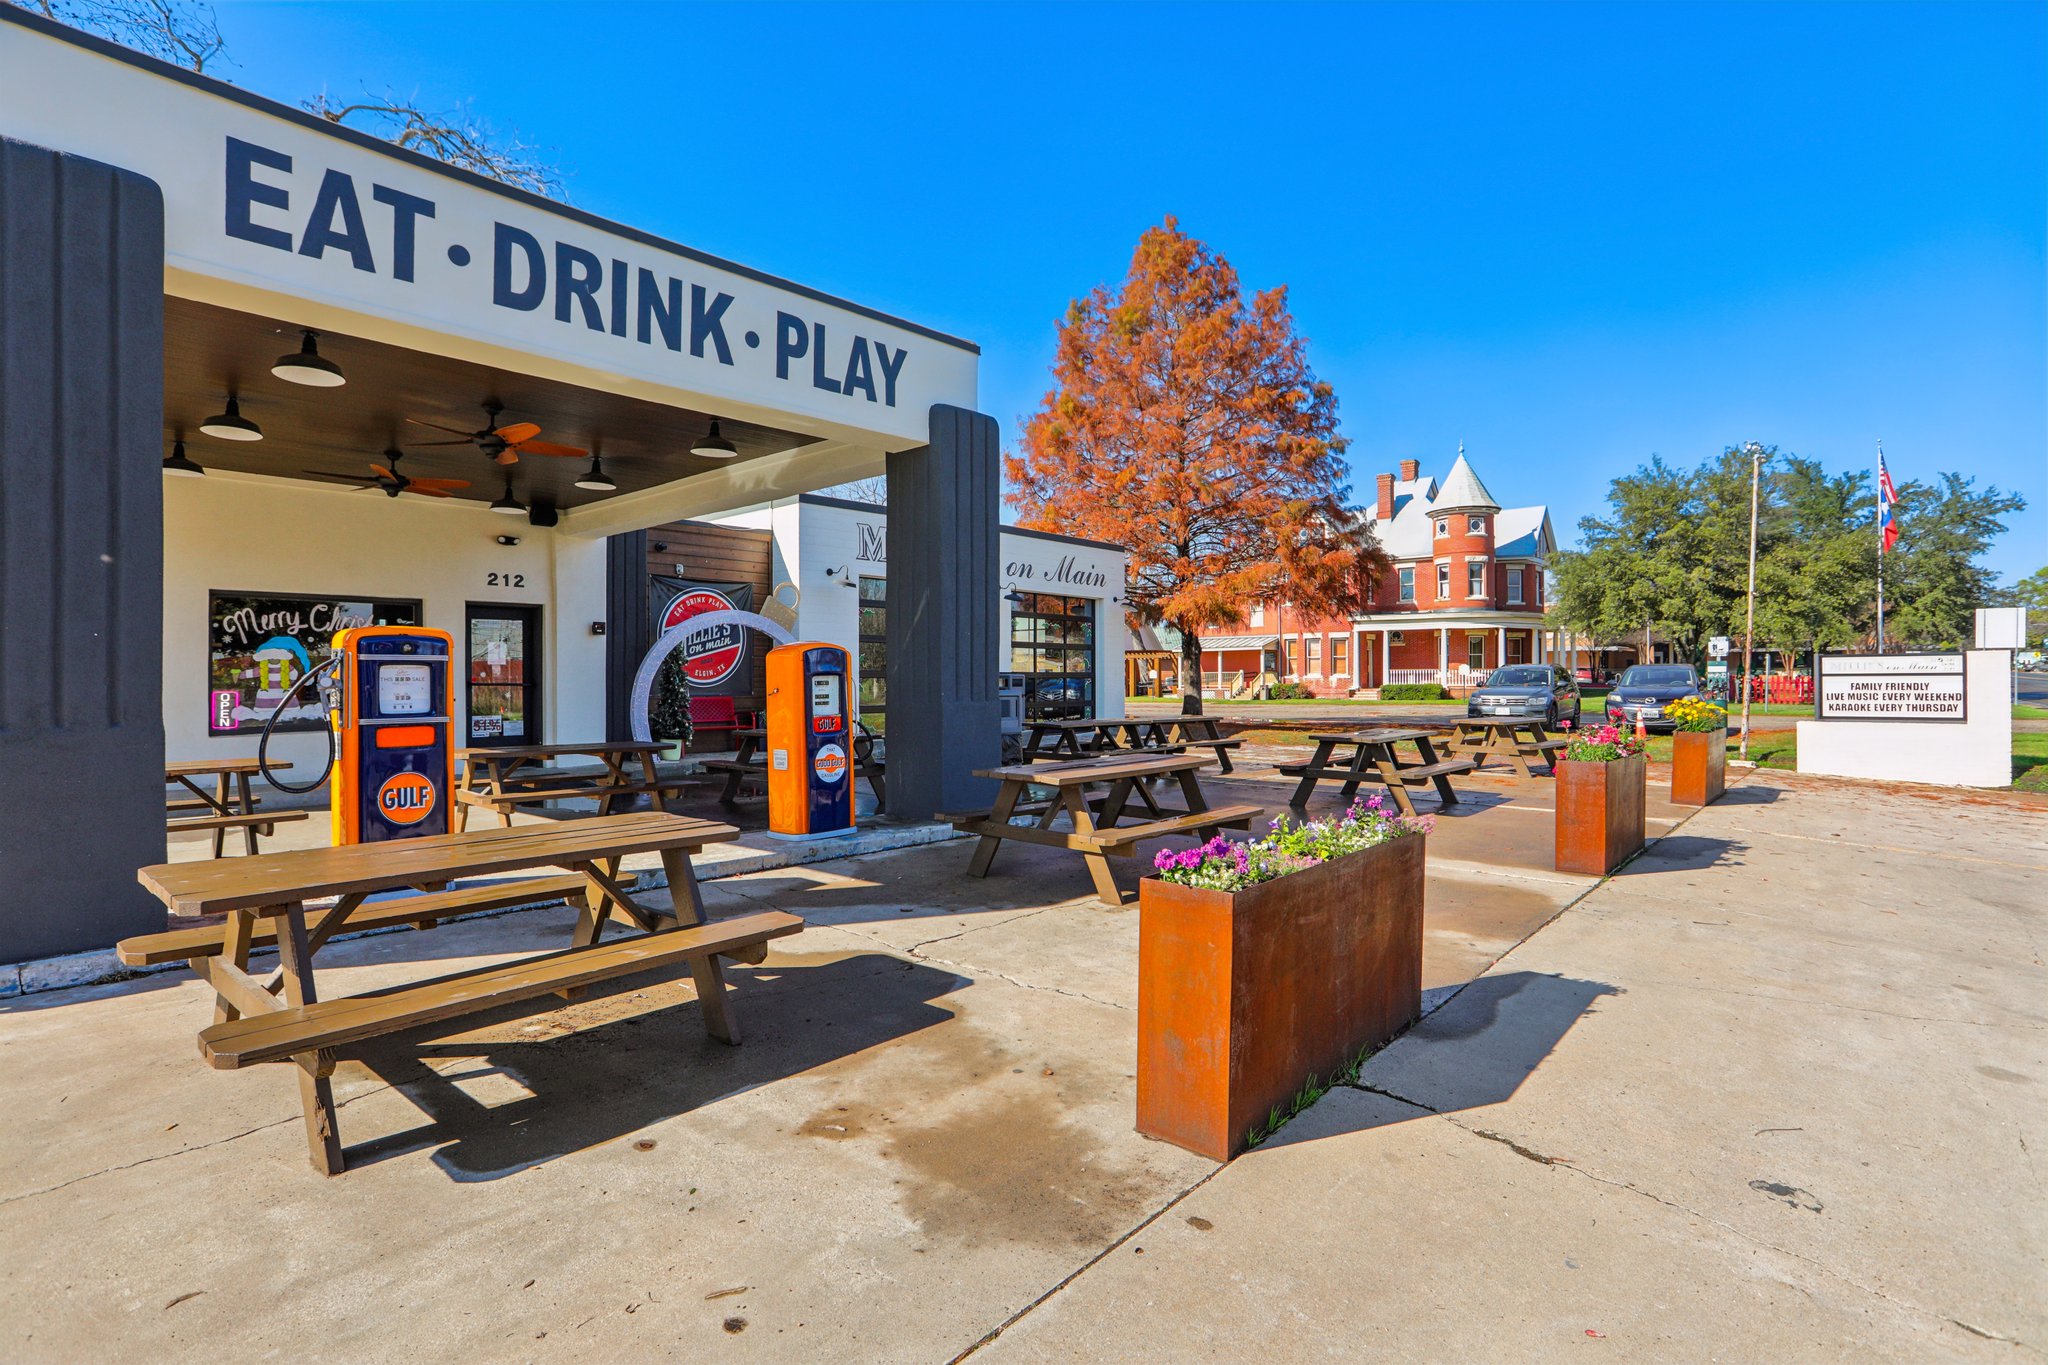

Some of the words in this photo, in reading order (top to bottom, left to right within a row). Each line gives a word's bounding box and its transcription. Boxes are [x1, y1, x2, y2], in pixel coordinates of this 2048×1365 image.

[225, 136, 436, 283] EAT
[493, 221, 735, 366] DRINK
[776, 310, 908, 407] PLAY
[487, 572, 525, 588] 212
[1005, 560, 1035, 579] on
[1043, 555, 1107, 588] Main
[674, 605, 685, 617] EAT
[686, 596, 706, 606] DRINK
[708, 598, 723, 609] PLAY
[223, 607, 308, 645] Merry
[684, 623, 731, 646] ILLIE'S
[689, 645, 704, 654] on
[705, 637, 732, 651] main
[717, 664, 725, 672] TX
[1850, 682, 1883, 691] FAMILY
[1885, 682, 1930, 691] FRIENDLY
[1826, 692, 1845, 701] LIVE
[1847, 692, 1879, 701] MUSIC
[1882, 692, 1912, 701] EVERY
[1914, 692, 1962, 701] WEEKEND
[219, 693, 231, 727] OPEN
[1828, 703, 1871, 712] KARAOKE
[1874, 703, 1904, 712] EVERY
[1905, 703, 1959, 713] THURSDAY
[818, 718, 836, 730] GULF
[382, 786, 430, 811] GULF
